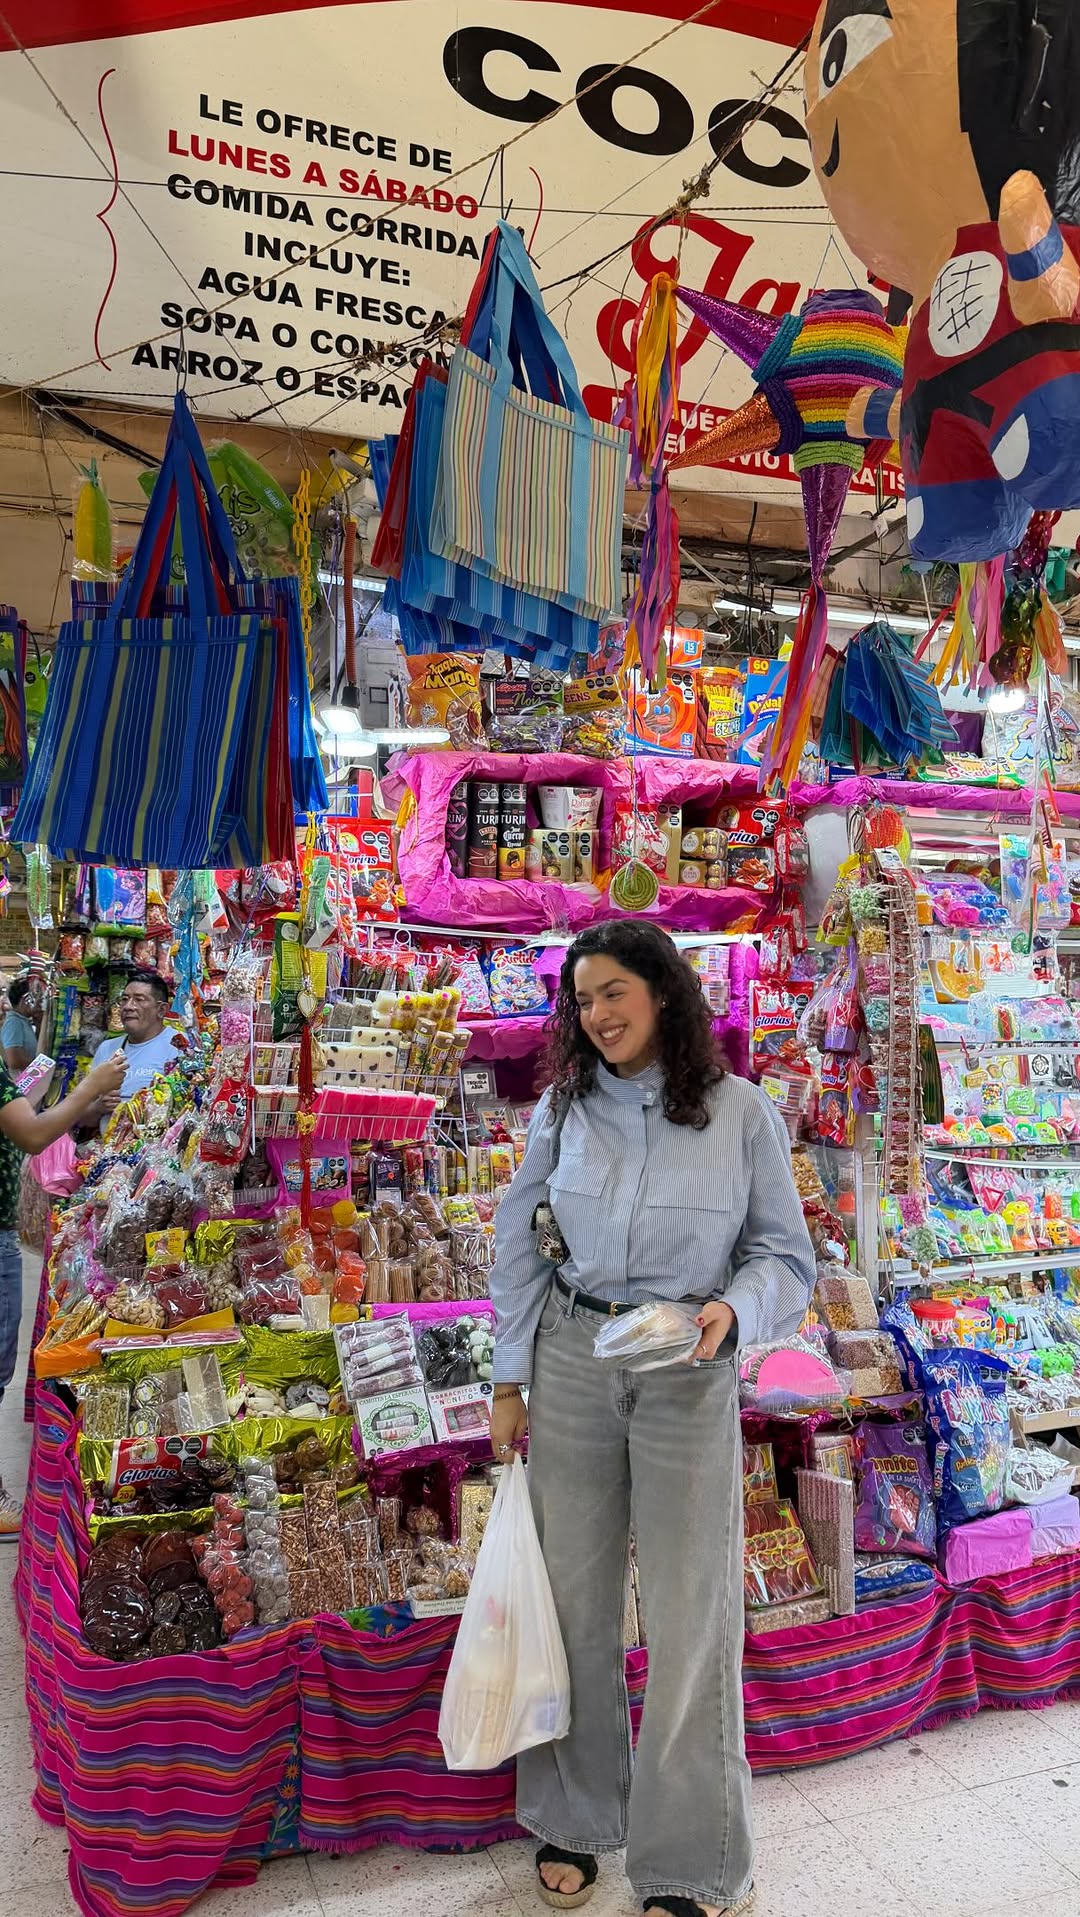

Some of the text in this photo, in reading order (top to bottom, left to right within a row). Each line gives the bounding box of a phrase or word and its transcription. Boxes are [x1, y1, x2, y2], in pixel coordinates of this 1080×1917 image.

[199, 94, 453, 173] LE OFRECE DE
[442, 26, 812, 189] COC
[167, 129, 480, 219] LUNES A SÁBADO
[166, 173, 480, 261] COMIDA CORRIDA
[244, 231, 411, 287] INCLUYE:
[198, 267, 449, 337] AGUA FRESCA
[160, 302, 450, 371] SOPA O CONSO
[131, 342, 412, 410] ARROZ O ESPA
[753, 660, 769, 670] 60
[728, 829, 760, 845] rias
[754, 1014, 792, 1028] Glorias
[118, 1466, 178, 1485] Glorias
